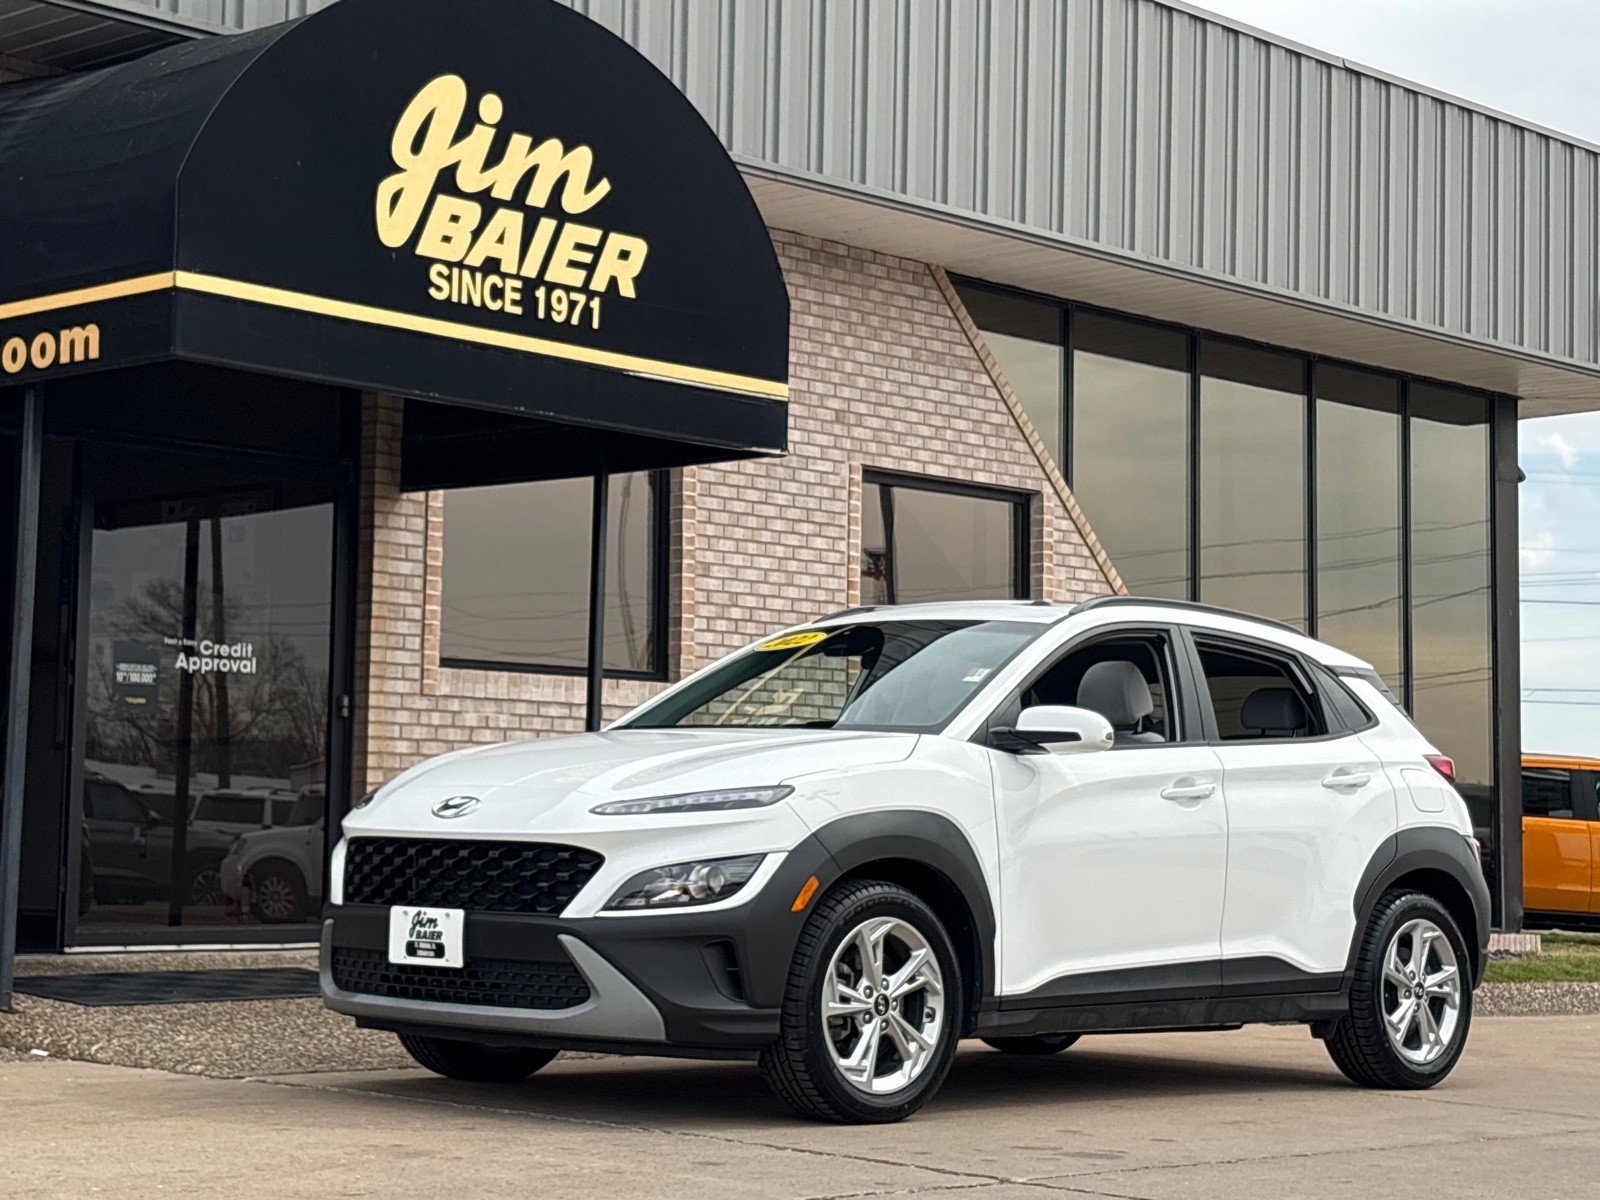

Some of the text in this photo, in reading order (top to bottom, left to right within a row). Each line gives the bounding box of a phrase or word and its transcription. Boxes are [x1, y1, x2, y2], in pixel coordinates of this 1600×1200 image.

[376, 74, 611, 248] Jim
[415, 194, 648, 299] BAIER
[428, 263, 601, 330] SINCE 1971
[2, 323, 100, 373] oom
[175, 652, 257, 674] Approval
[200, 640, 253, 658] Credit
[408, 909, 439, 939] Jim
[416, 930, 443, 940] BAIER
